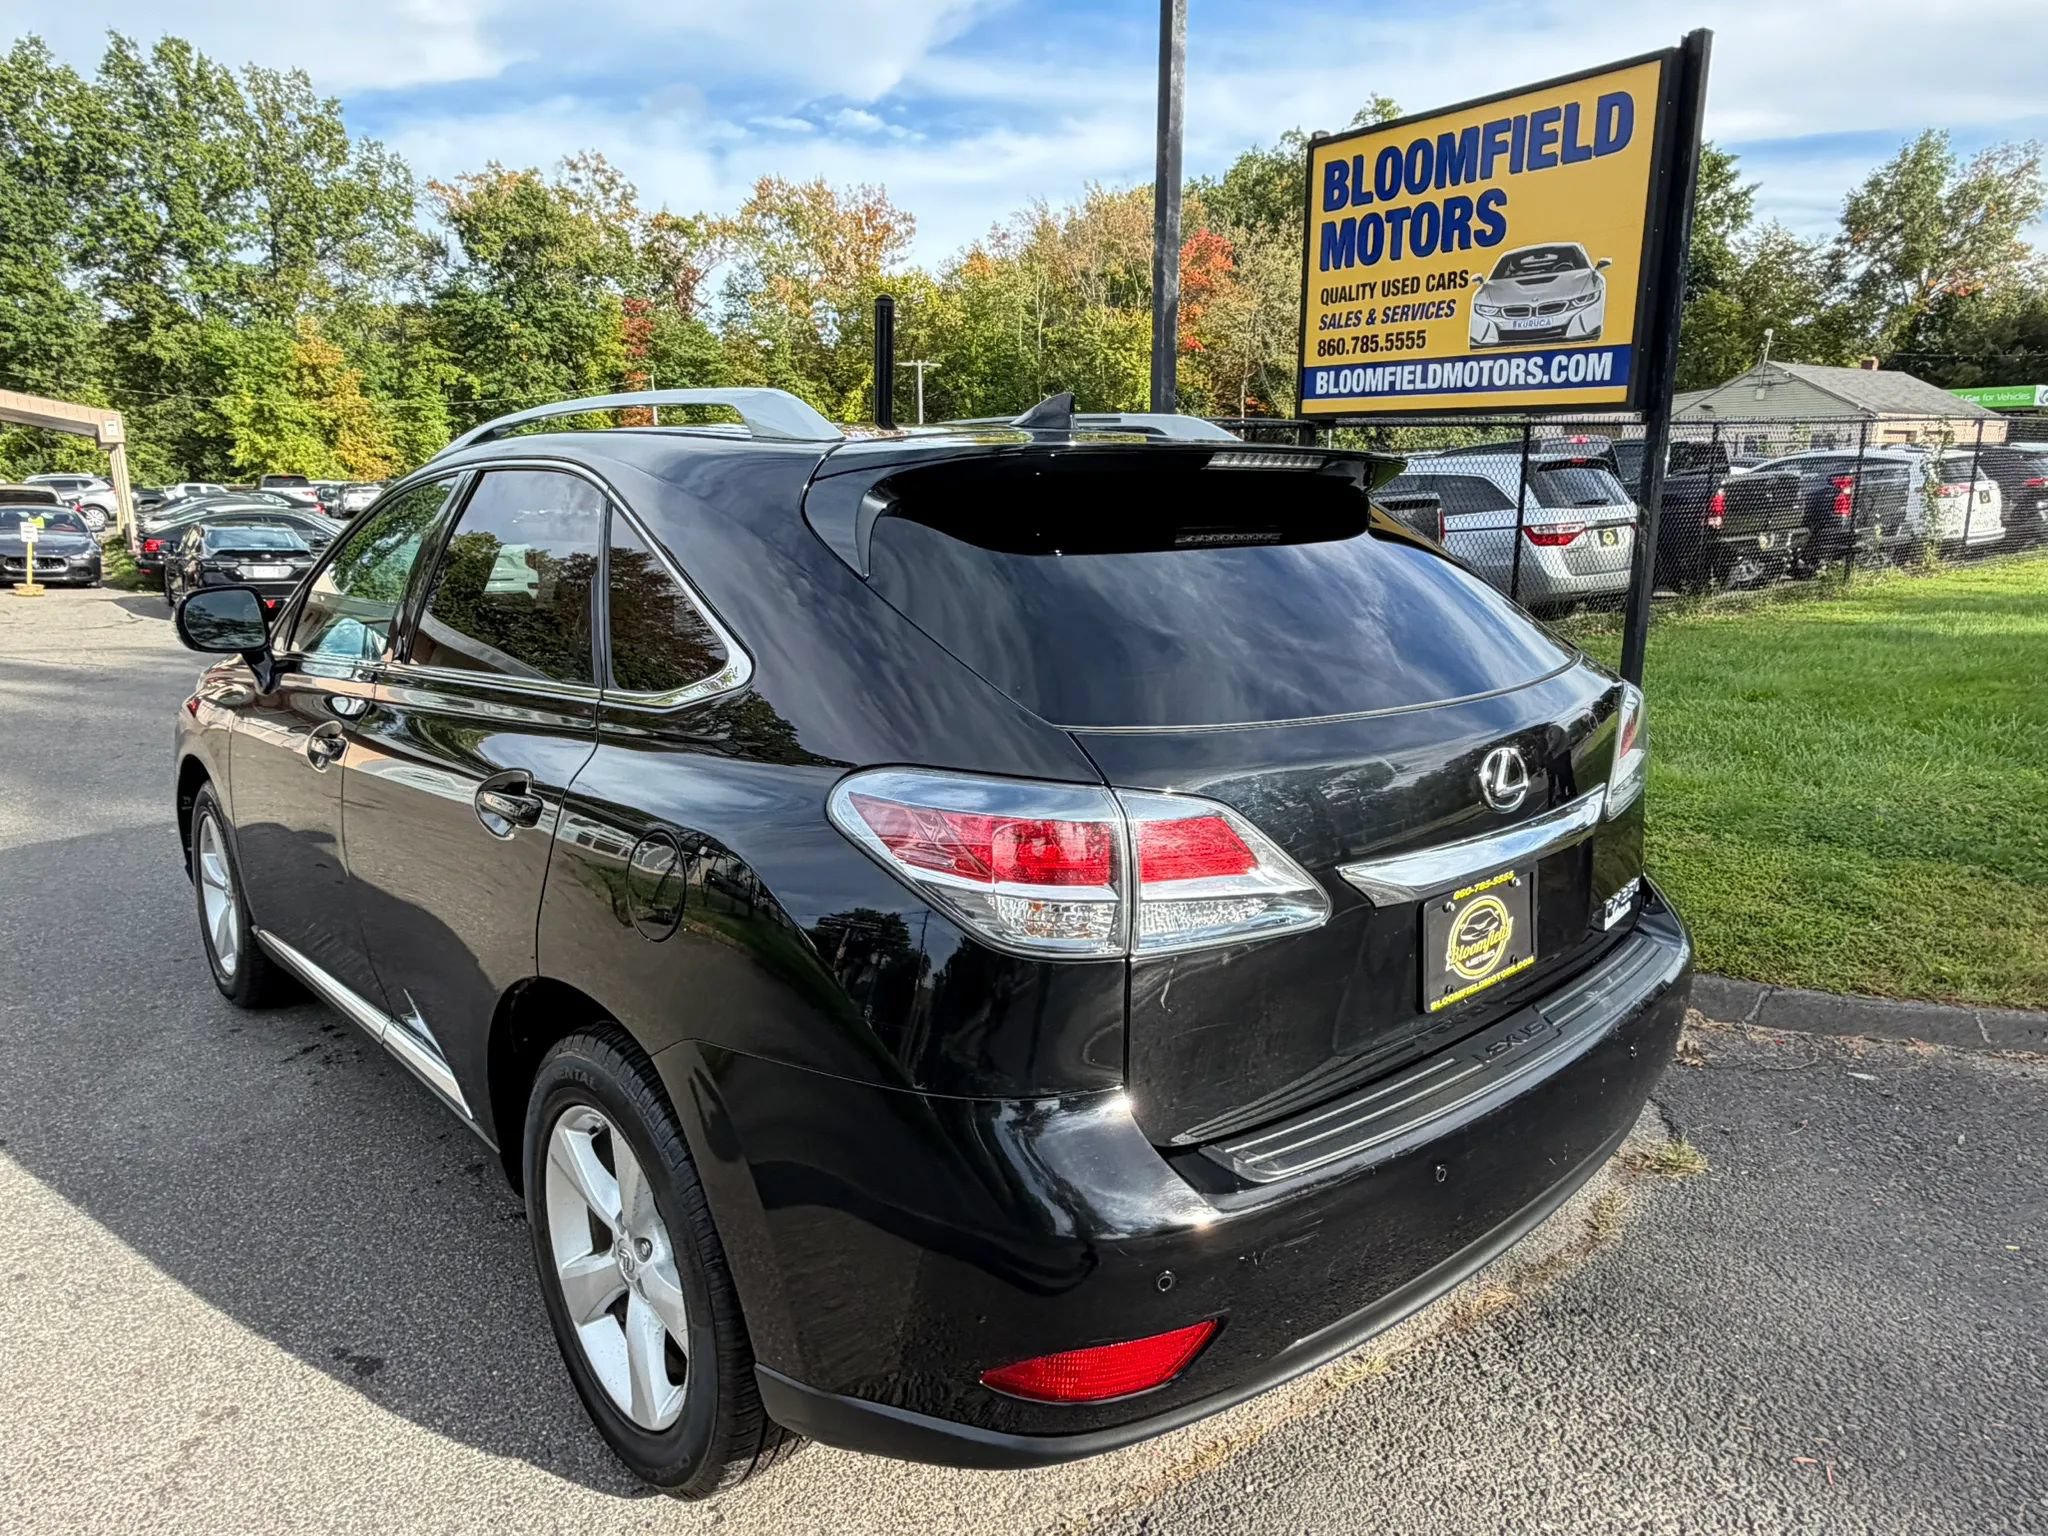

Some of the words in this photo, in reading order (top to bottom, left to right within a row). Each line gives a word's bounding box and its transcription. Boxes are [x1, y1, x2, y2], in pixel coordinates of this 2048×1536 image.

[1323, 91, 1634, 212] BLOOMFIELD
[1320, 188, 1507, 272] MOTORS
[1320, 282, 1377, 306] QUALITY
[1382, 276, 1420, 302] USED
[1426, 270, 1469, 292] CARS
[1319, 309, 1362, 331] SALES
[1366, 308, 1376, 325] &
[1380, 299, 1456, 324] SERVICES
[1317, 329, 1426, 357] 860.785.5555
[1315, 352, 1614, 395] BLOOMFIELDMOTORS.COM
